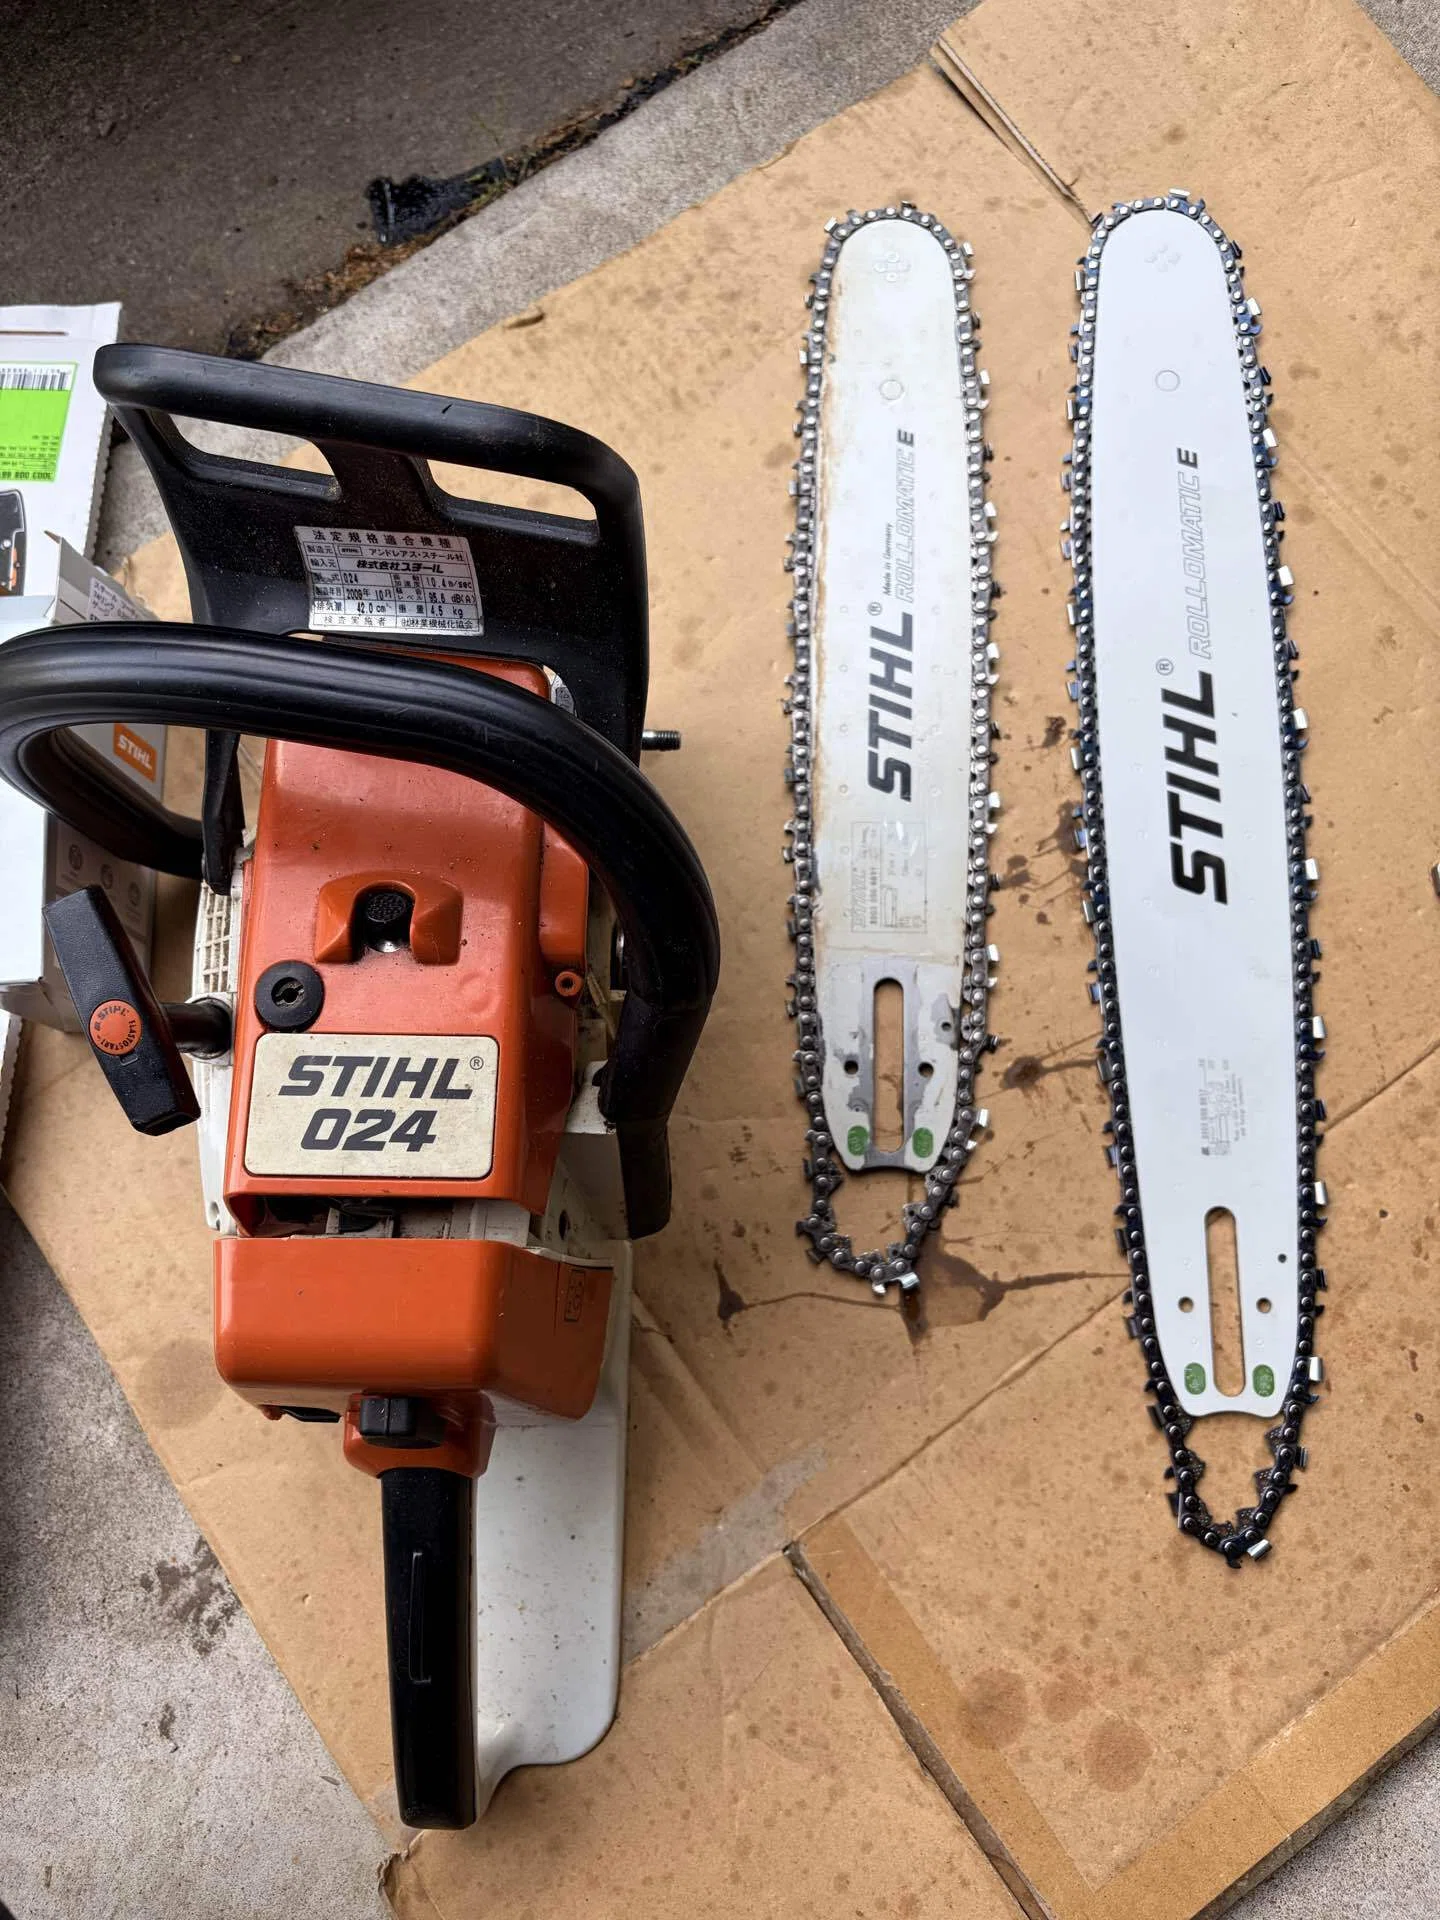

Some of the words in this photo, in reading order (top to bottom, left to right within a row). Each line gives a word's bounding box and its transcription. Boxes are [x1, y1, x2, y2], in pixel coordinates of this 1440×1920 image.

[897, 429, 915, 448] E
[1176, 447, 1199, 469] E
[896, 448, 915, 604] ROLLOMATIC
[343, 573, 359, 583] 024
[1177, 471, 1212, 661] ROLLOMATIC
[882, 572, 892, 597] Made
[118, 734, 153, 770] STIHL
[300, 1108, 438, 1152] 024
